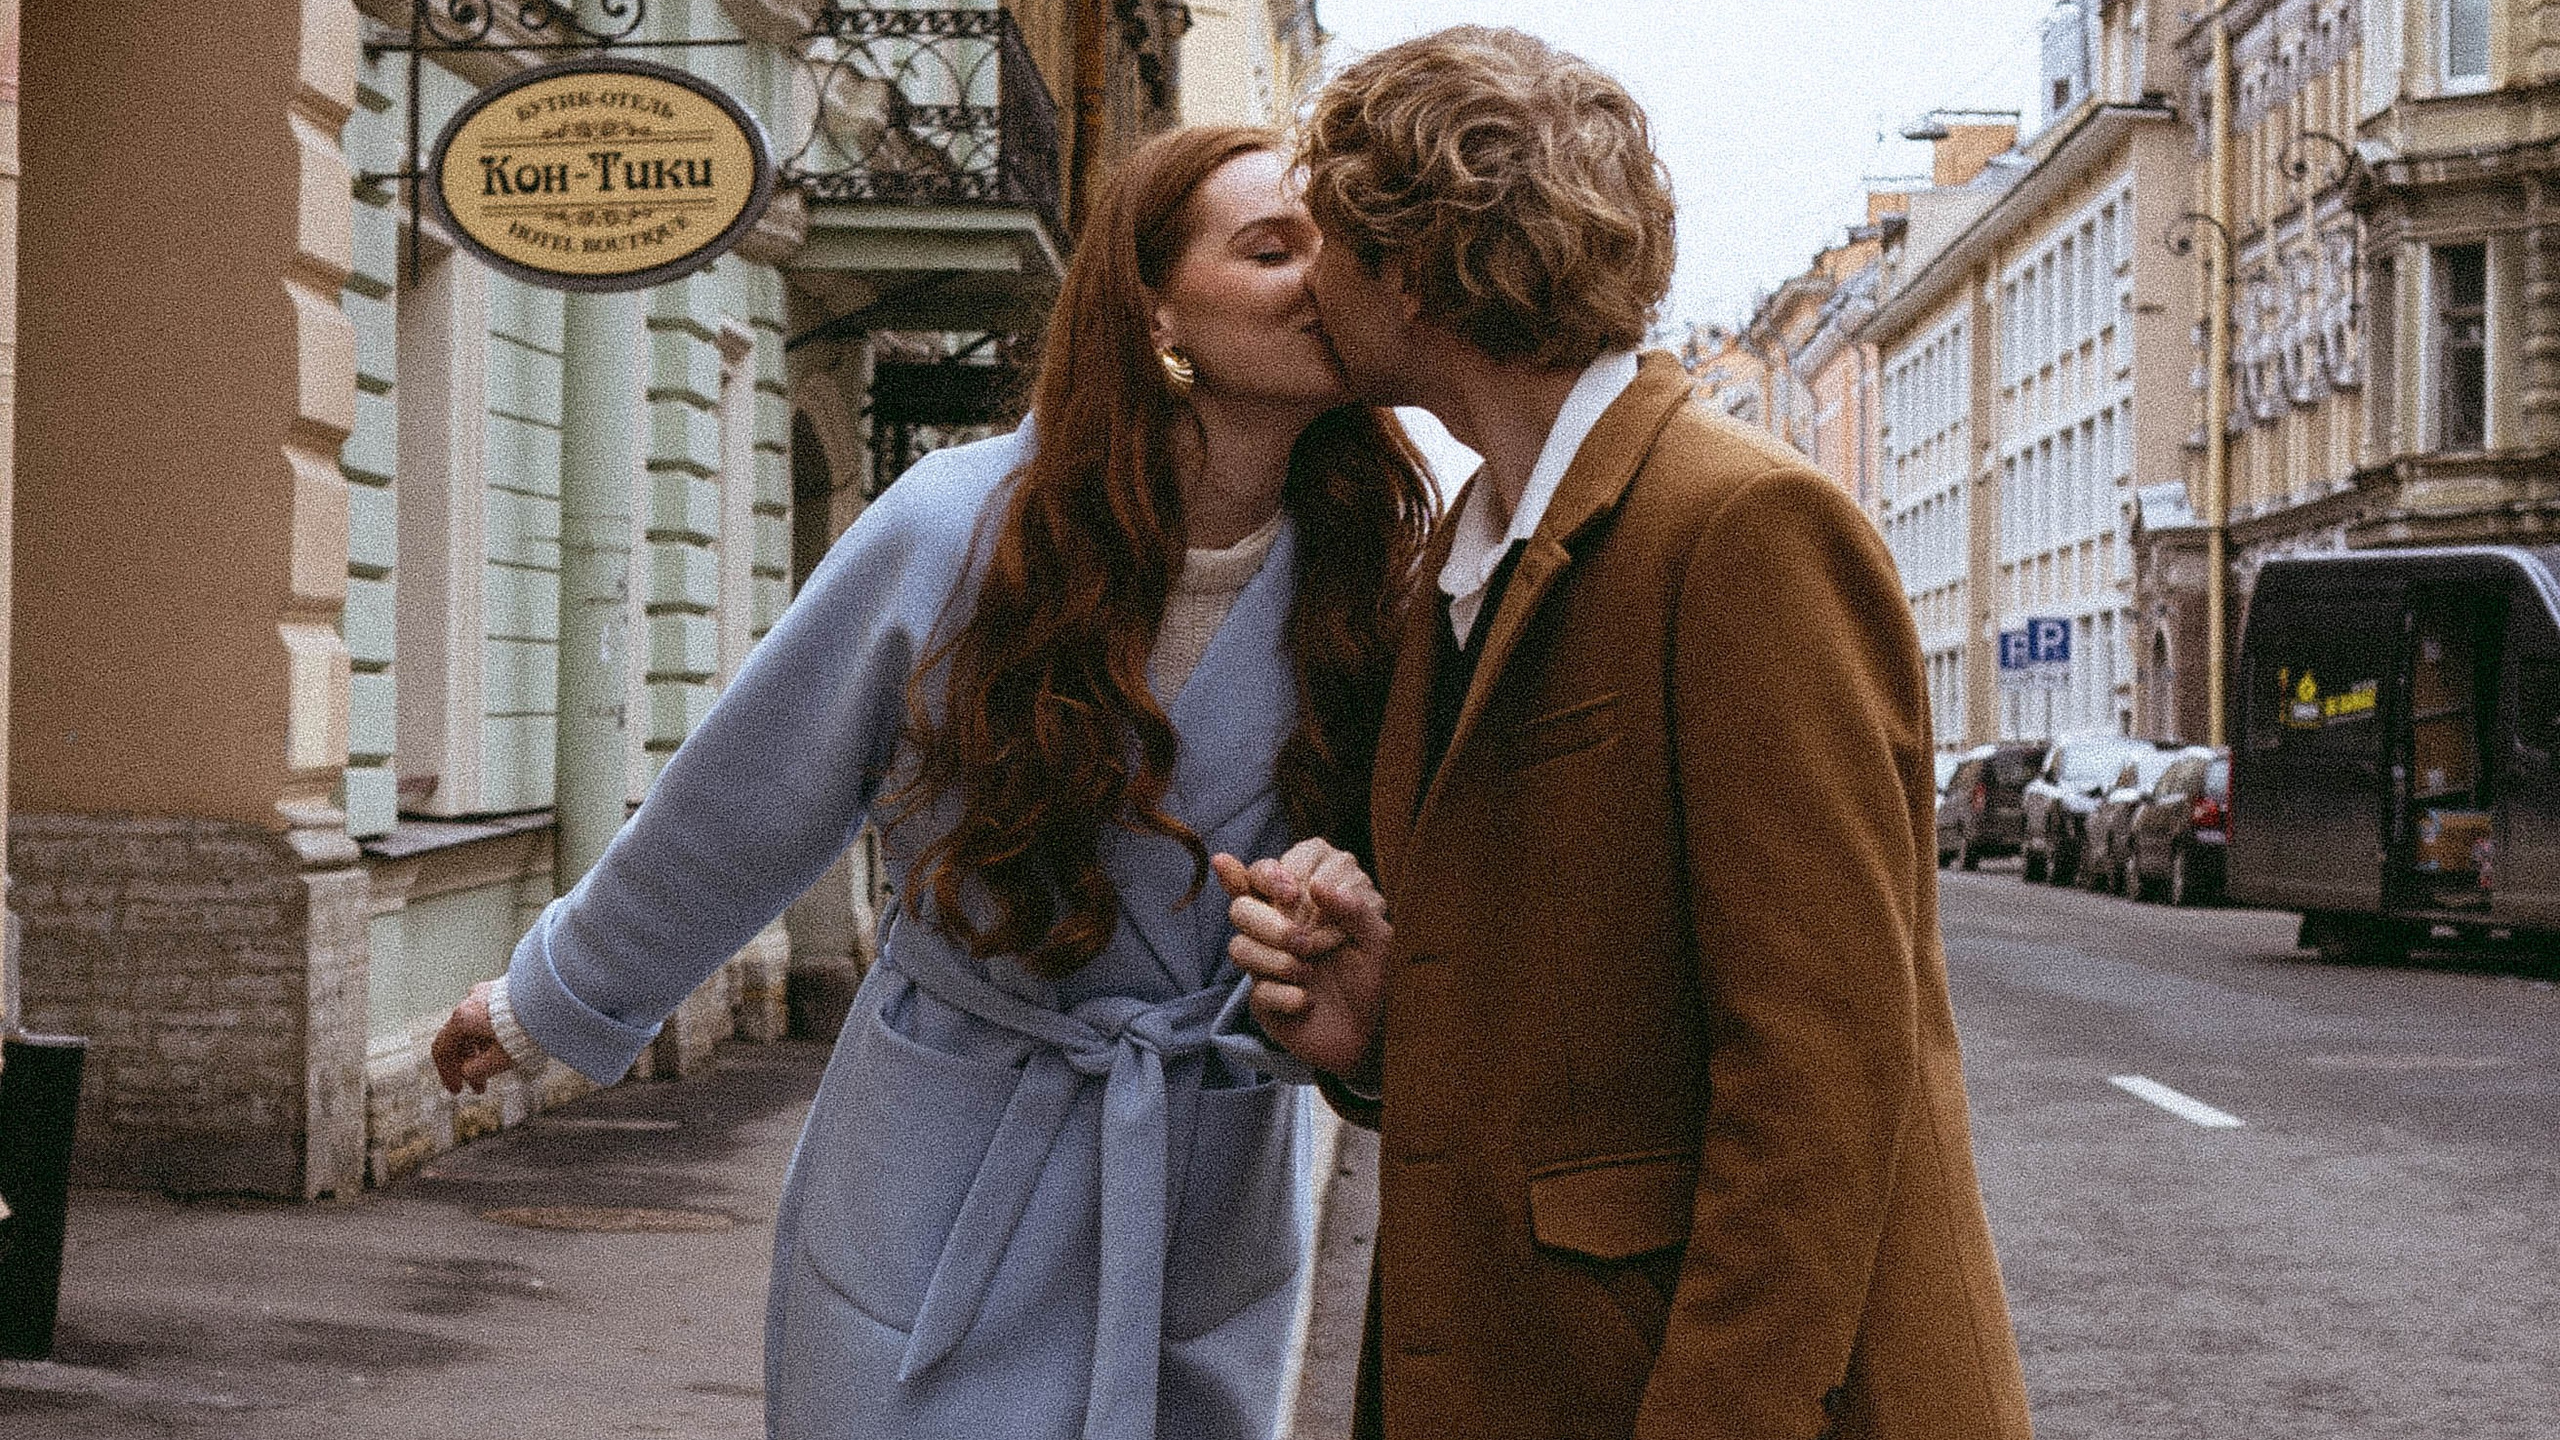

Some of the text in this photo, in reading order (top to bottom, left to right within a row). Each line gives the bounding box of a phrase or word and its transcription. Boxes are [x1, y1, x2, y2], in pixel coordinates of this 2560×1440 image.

[515, 90, 675, 121] БУТИК-ОТЕЛЬ
[477, 150, 714, 195] Кон-Тики
[508, 214, 690, 252] HOTEL BOUTIQUE
[2038, 622, 2063, 660] P
